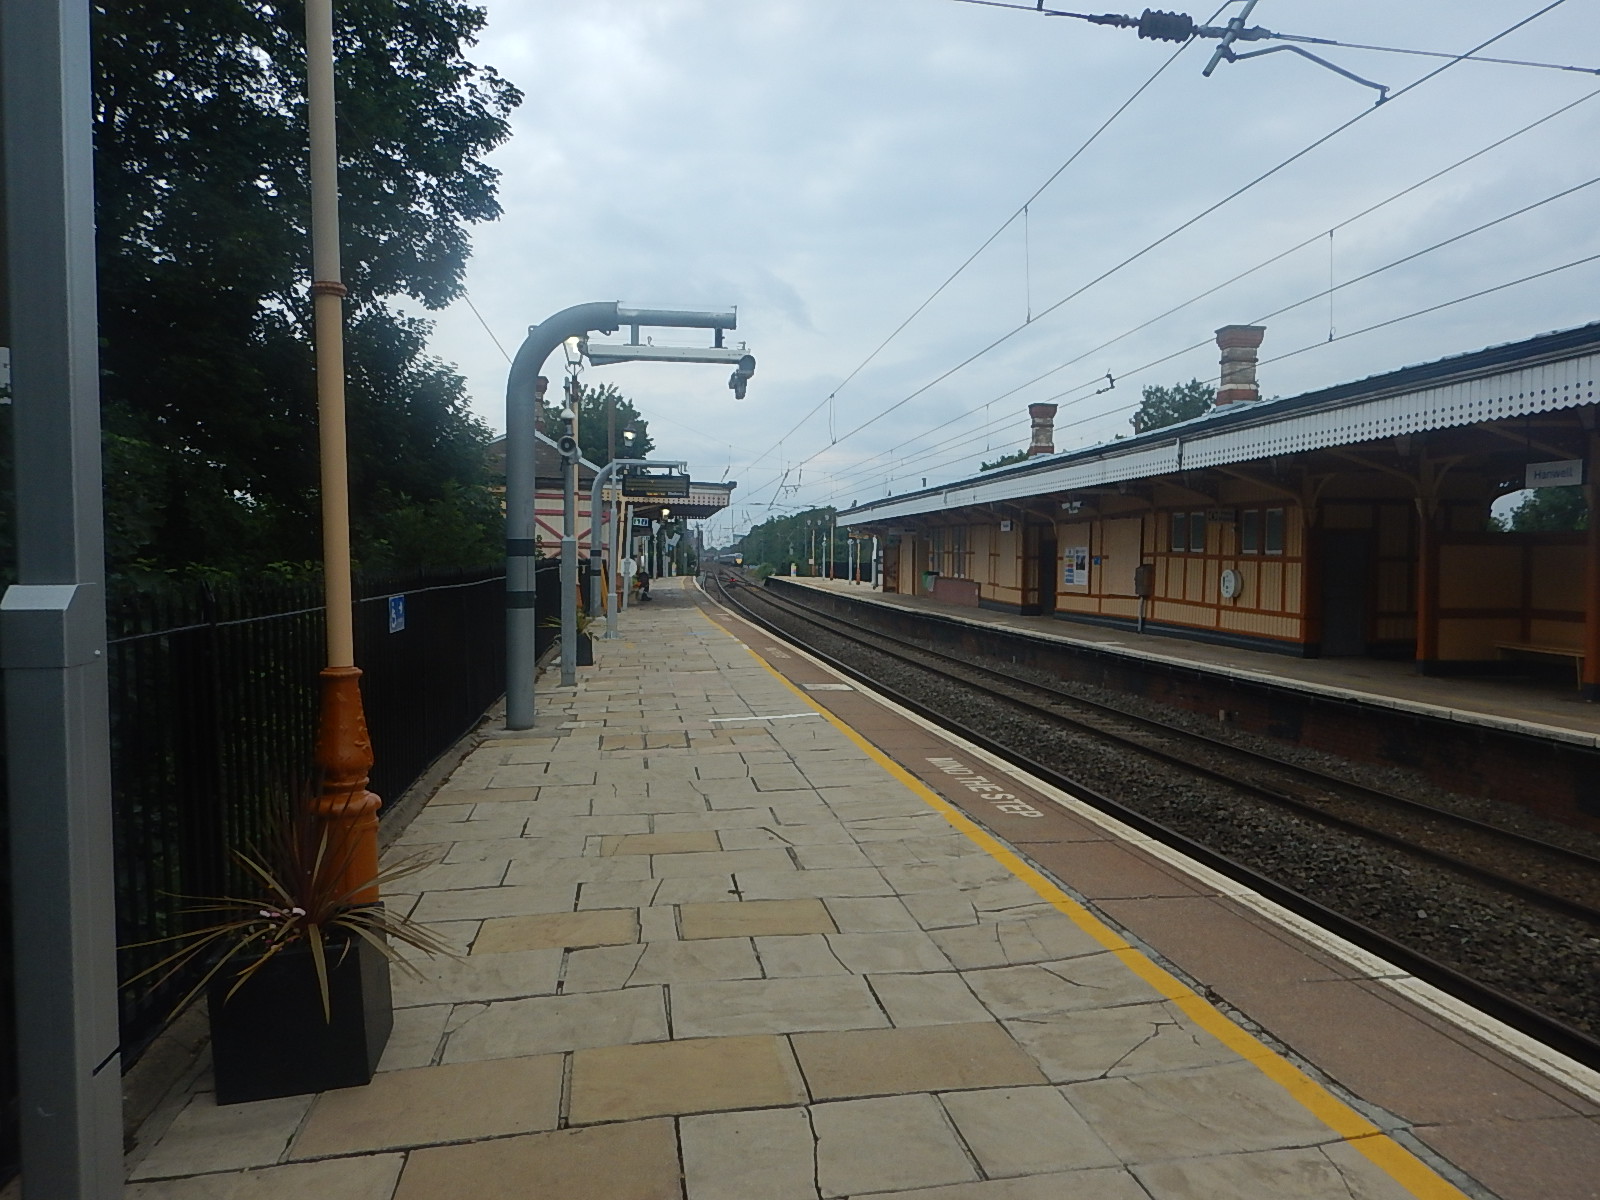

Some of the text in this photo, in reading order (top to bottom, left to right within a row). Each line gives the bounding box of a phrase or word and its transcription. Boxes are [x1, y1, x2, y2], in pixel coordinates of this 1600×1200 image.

[1534, 467, 1573, 479] Hanwell
[925, 757, 1044, 818] MIND THE STEP
